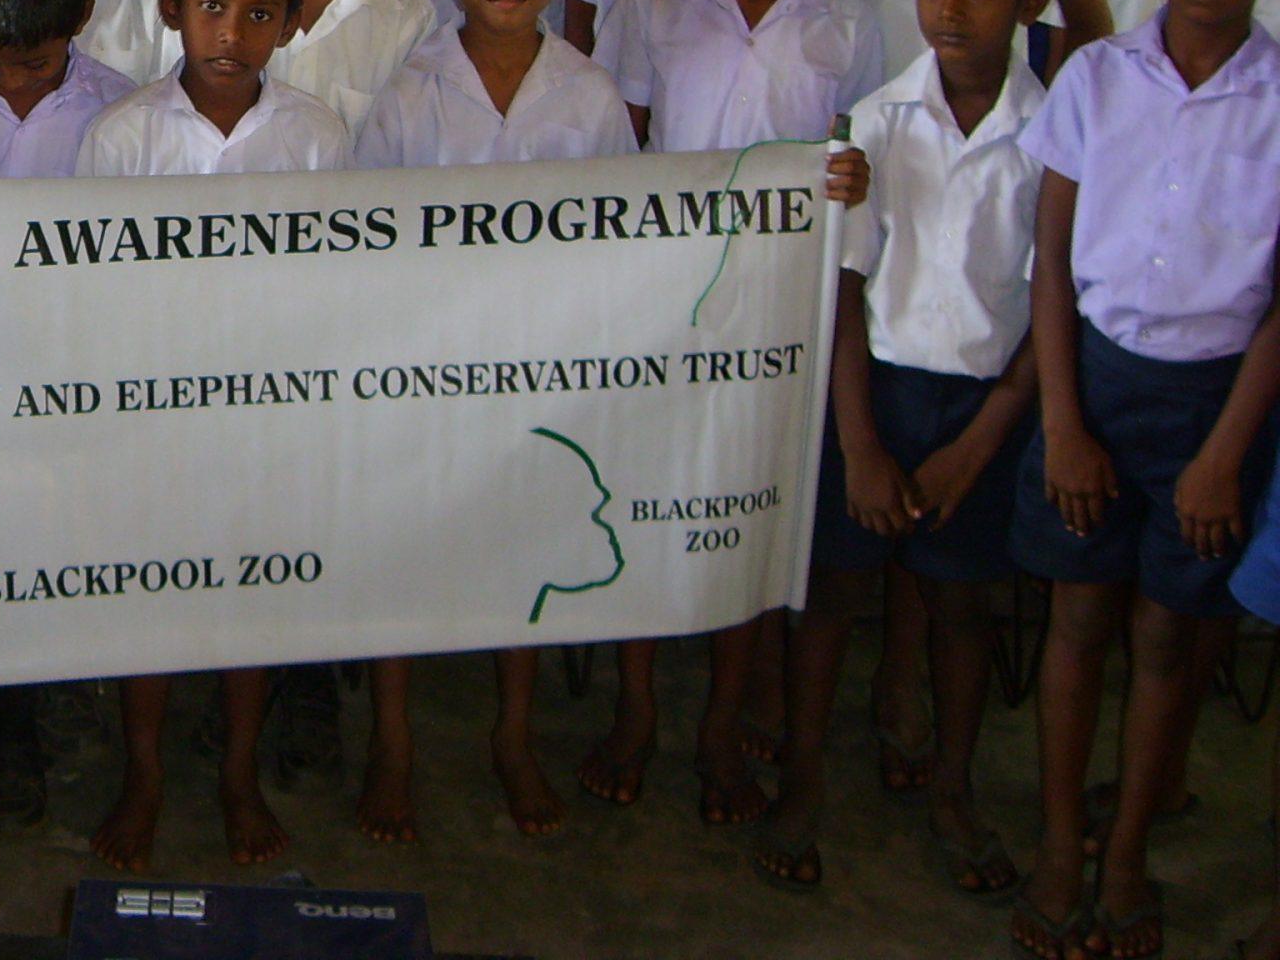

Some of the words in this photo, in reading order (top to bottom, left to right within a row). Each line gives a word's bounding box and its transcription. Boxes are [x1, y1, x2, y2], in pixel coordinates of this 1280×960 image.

[13, 206, 398, 269] AWARENESS
[418, 186, 814, 248] PROGRAMME
[12, 382, 101, 418] AND
[115, 369, 339, 412] ELEPHANT
[352, 354, 669, 400] CONSERVATION
[681, 342, 805, 384] TRUST
[631, 485, 781, 522] BLACKPOOL
[685, 527, 741, 553] ZOO
[237, 551, 323, 587] ZOO
[293, 900, 396, 920] BenQ
